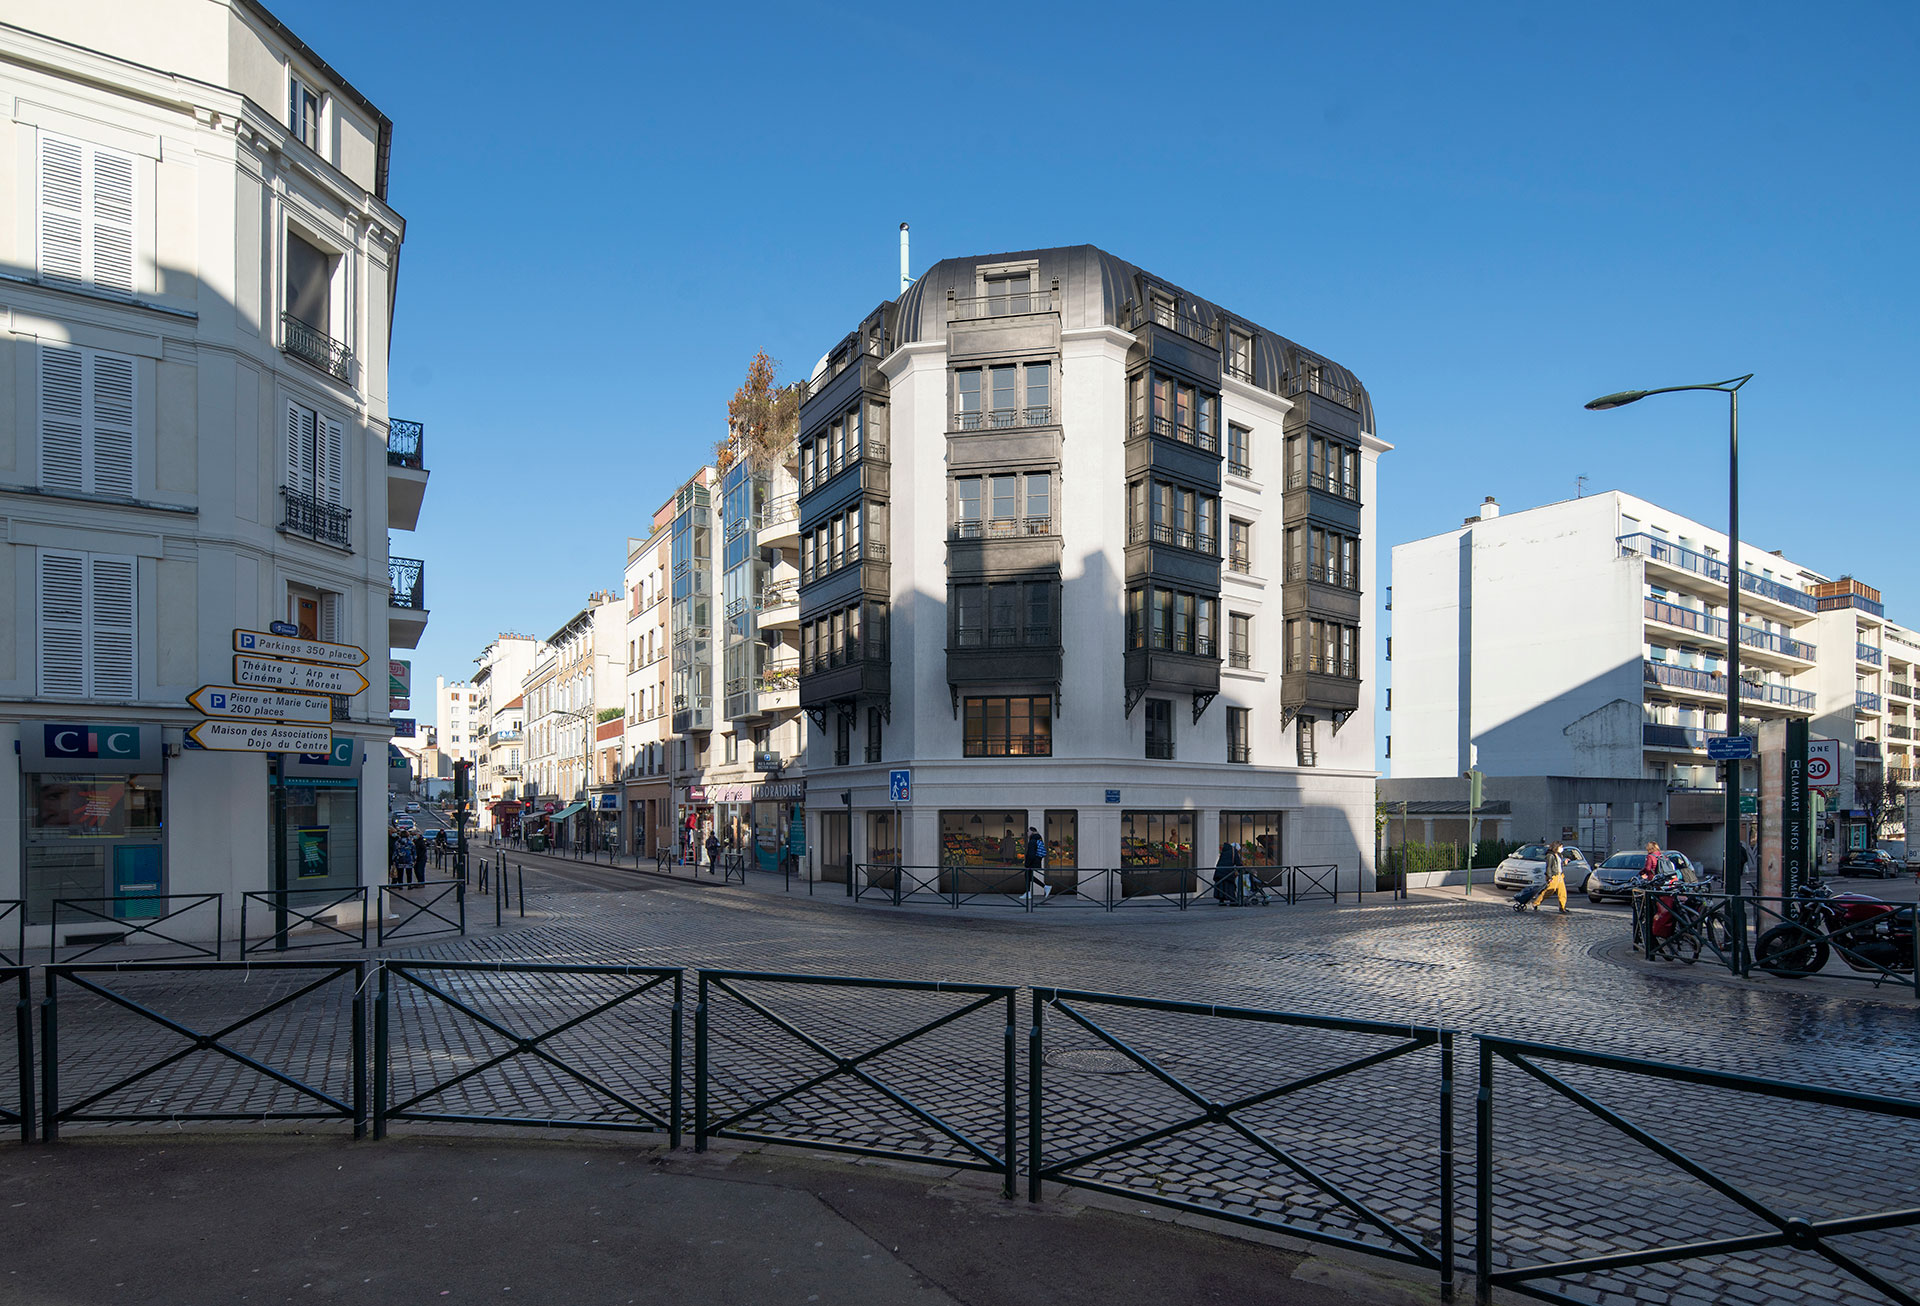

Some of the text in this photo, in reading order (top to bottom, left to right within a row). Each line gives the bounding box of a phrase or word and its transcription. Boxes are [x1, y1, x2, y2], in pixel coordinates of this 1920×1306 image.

[243, 635, 357, 661] P Parkings 350 places
[242, 660, 340, 680] Théâtre J. Arp et
[242, 671, 342, 690] Cinéma J. Moreau
[213, 693, 328, 710] P Pierre et Marie Curie
[230, 704, 284, 716] 260 places
[54, 731, 131, 753] CIC
[211, 725, 328, 740] Maison des Associations
[247, 738, 328, 751] Dojo du Centre
[1809, 763, 1826, 773] 30
[1791, 768, 1800, 812] CLAMART
[1790, 821, 1799, 850] INFOS
